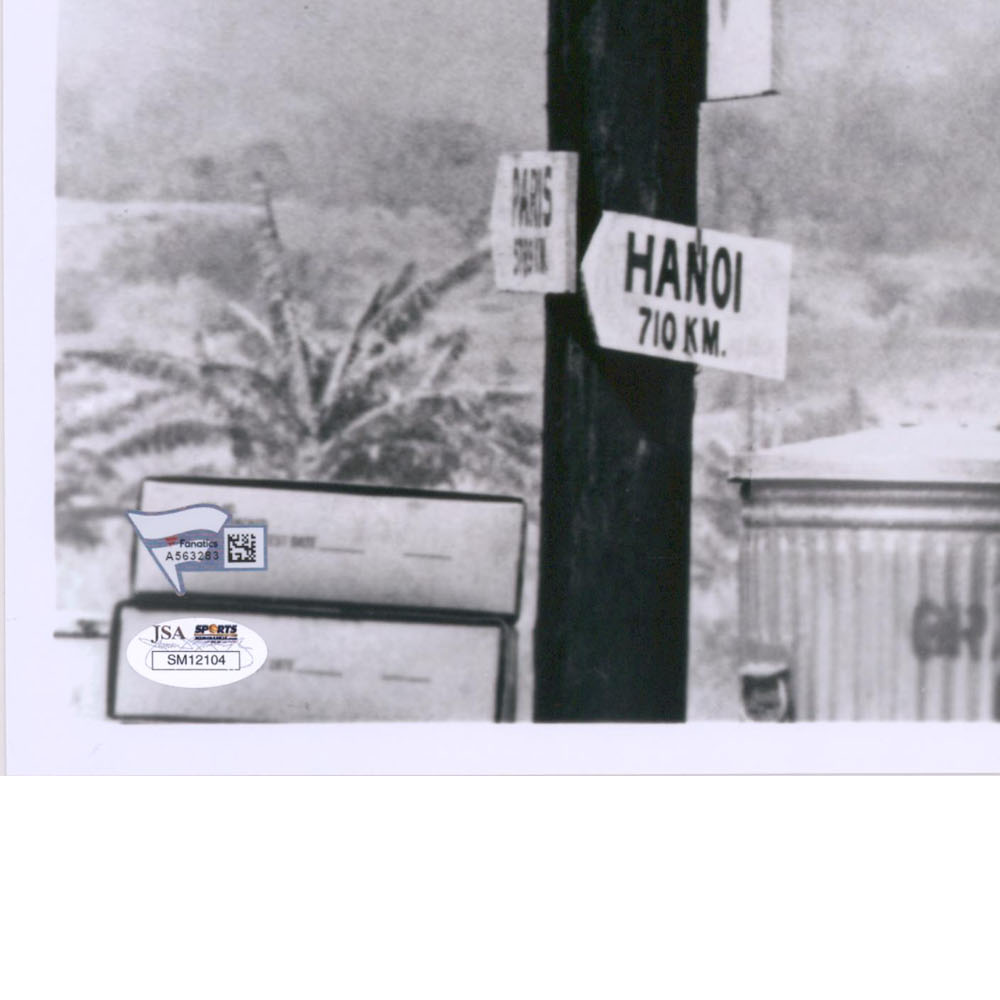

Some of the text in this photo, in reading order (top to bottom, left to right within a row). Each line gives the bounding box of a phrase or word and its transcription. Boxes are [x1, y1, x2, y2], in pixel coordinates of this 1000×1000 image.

[624, 230, 743, 314] HANOI
[638, 306, 727, 358] 710 KM.
[179, 538, 219, 549] Fanatics
[165, 551, 220, 562] A563283
[150, 624, 187, 644] JSA
[167, 654, 227, 666] SM12104
